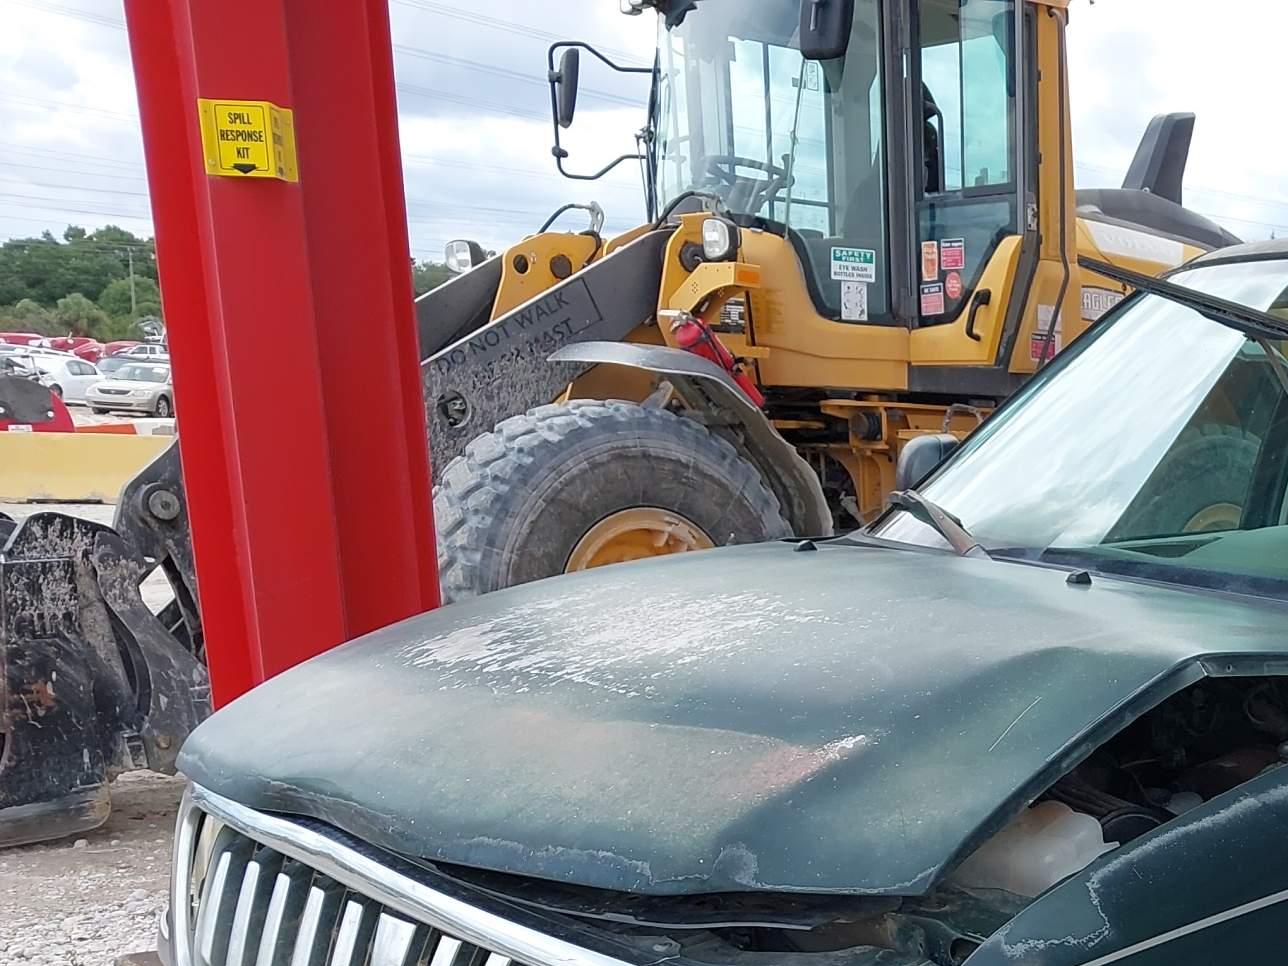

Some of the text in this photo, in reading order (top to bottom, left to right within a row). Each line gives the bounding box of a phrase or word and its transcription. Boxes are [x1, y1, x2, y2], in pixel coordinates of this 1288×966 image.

[228, 112, 252, 125] SPILL
[219, 130, 264, 142] RESPONSE
[236, 147, 250, 159] KIT
[835, 250, 871, 259] SAFETY
[437, 349, 467, 376] DO
[469, 323, 513, 354] NOT
[515, 291, 570, 330] WALK
